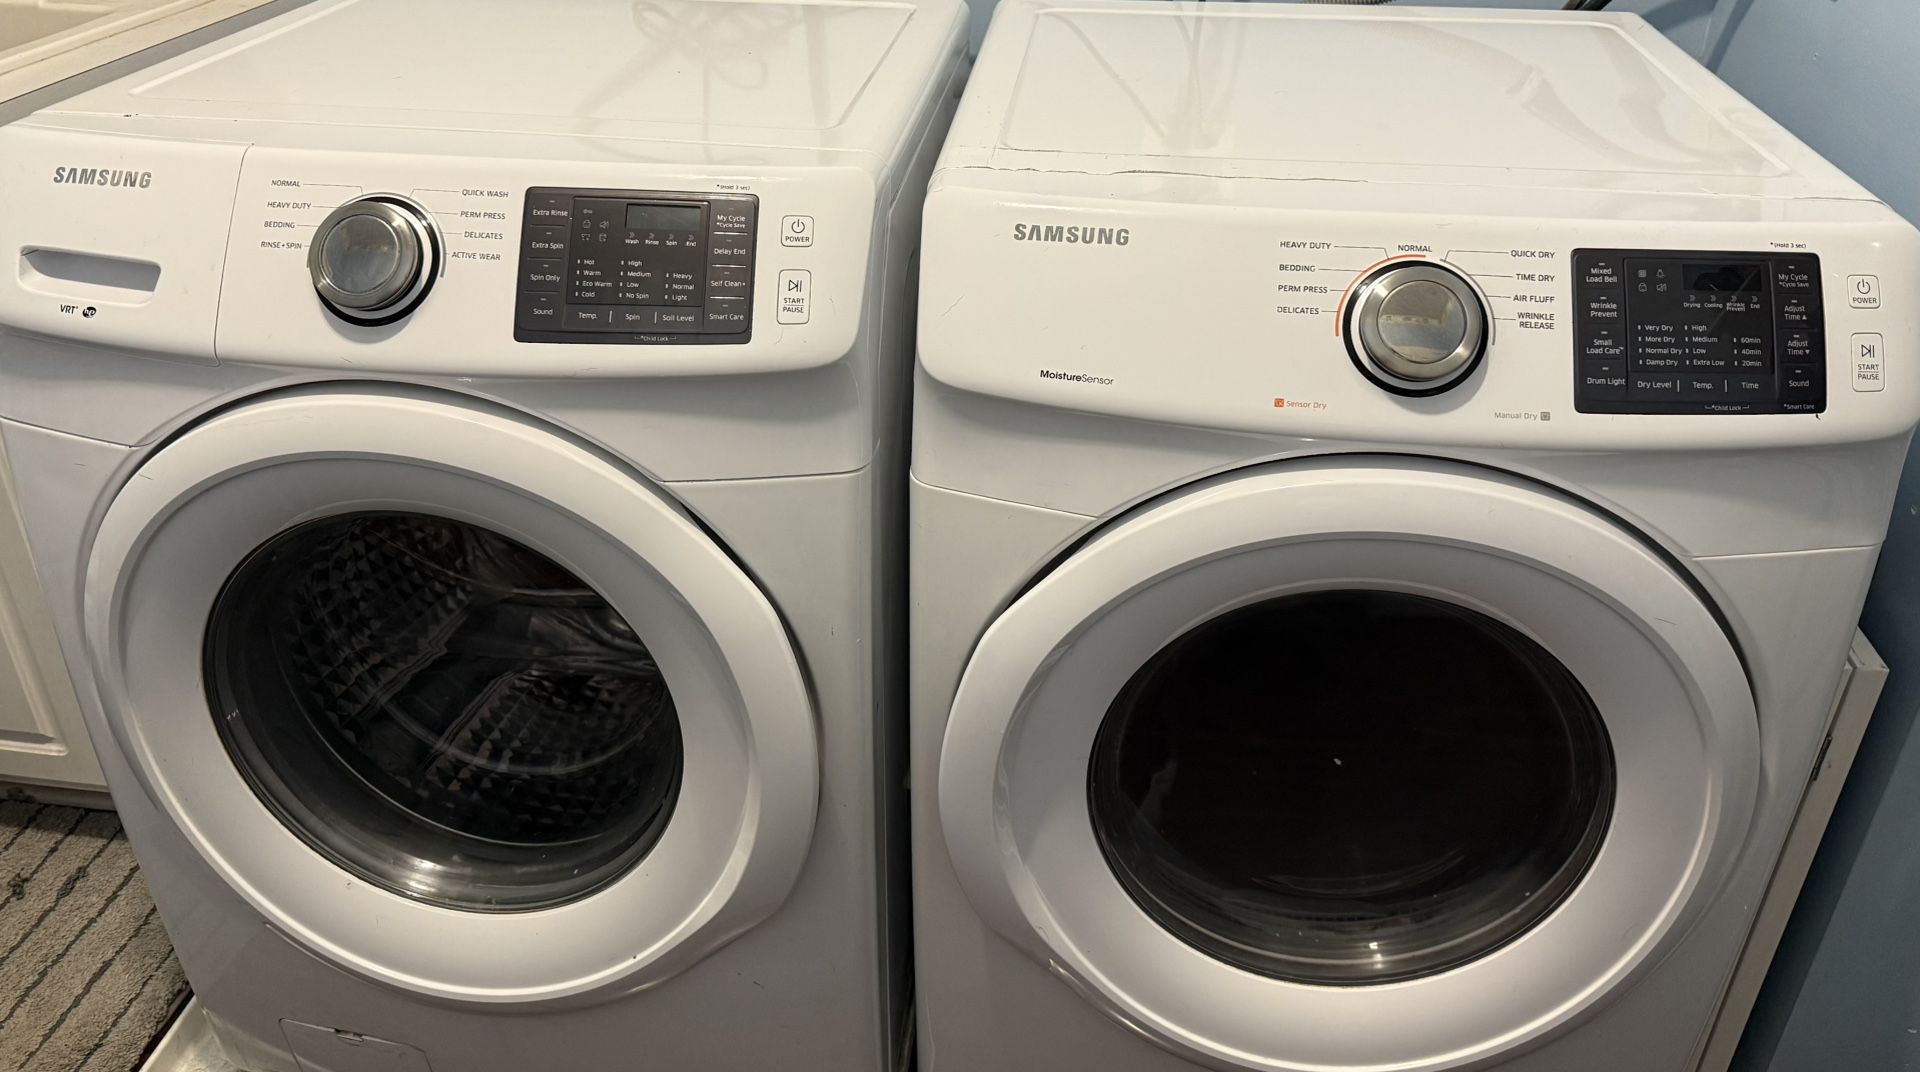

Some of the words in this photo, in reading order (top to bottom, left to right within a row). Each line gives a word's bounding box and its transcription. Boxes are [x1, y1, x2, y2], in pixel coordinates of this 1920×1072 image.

[53, 167, 152, 189] SAMSUNG
[462, 188, 484, 196] QUICK
[717, 214, 727, 222] My
[464, 231, 504, 240] DELICATES
[1014, 223, 1130, 246] SAMSUNG
[714, 248, 732, 256] Delay
[1398, 244, 1432, 252] NORMAL
[452, 252, 477, 260] ACTIVE
[479, 252, 501, 260] WEAR
[1510, 250, 1536, 258] QUICK
[628, 260, 642, 268] High
[1279, 264, 1316, 272] BEDDING
[545, 274, 560, 282] Only
[1516, 274, 1536, 282] TIME
[1303, 285, 1328, 294] PRESS
[1276, 306, 1319, 314] DELICATES
[1517, 312, 1555, 320] WRINKLE
[1520, 322, 1555, 330] RELEASE
[1040, 370, 1114, 386] MoistureSensor
[1608, 378, 1626, 386] Light
[1692, 382, 1714, 390] Temp.
[1313, 402, 1328, 410] Dry
[1524, 412, 1538, 421] Dry
